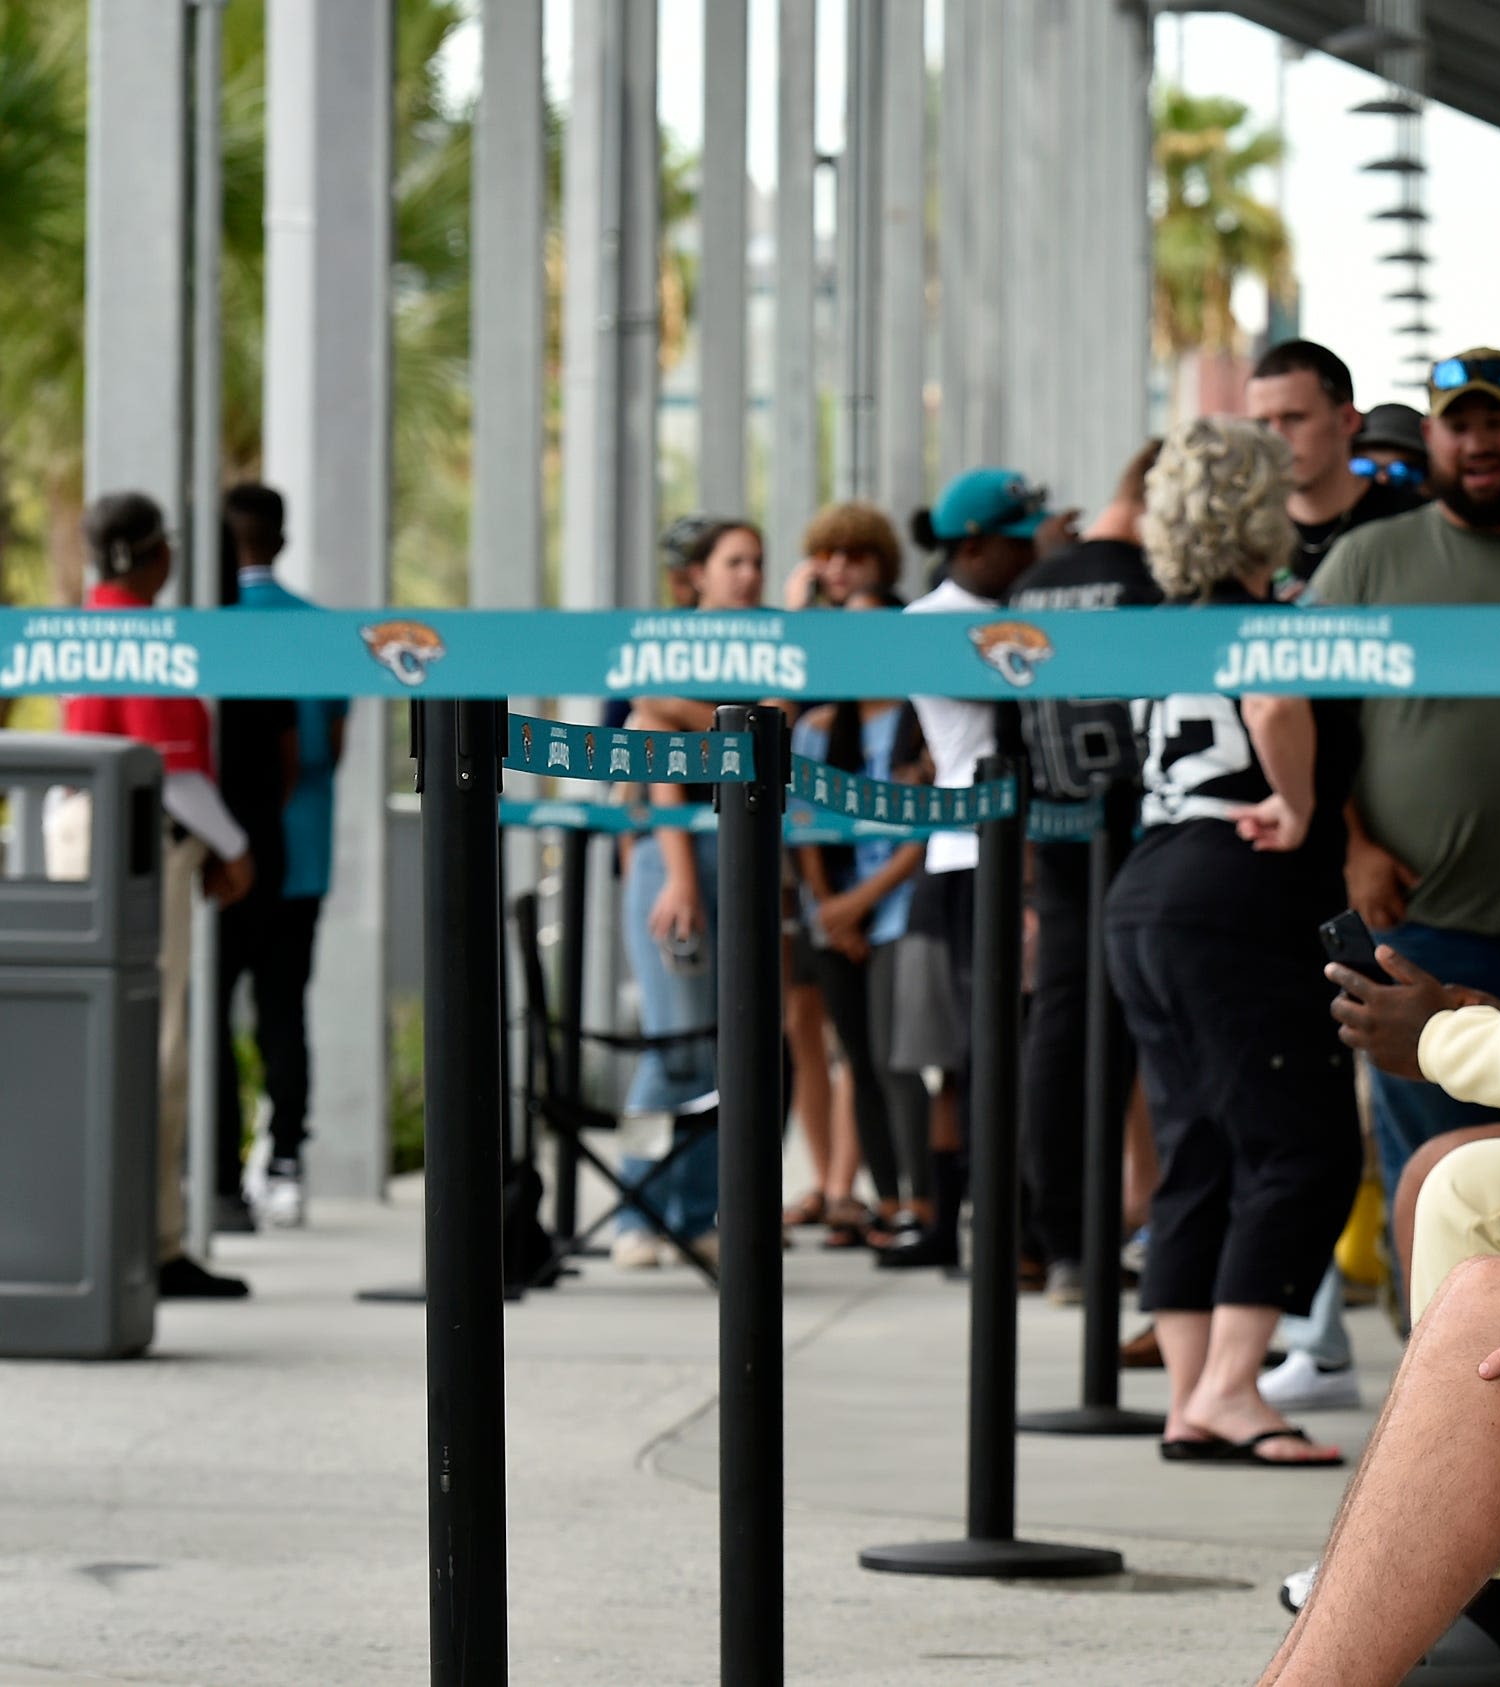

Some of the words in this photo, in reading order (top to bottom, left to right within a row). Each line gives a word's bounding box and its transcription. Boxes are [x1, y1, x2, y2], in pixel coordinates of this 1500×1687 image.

[24, 617, 176, 639] JACKSONVILLE
[631, 617, 784, 639] JACKSONVILLE
[0, 639, 199, 689] JAGUARS
[605, 640, 808, 690] JAGUARS
[1214, 638, 1416, 689] JAGUARS
